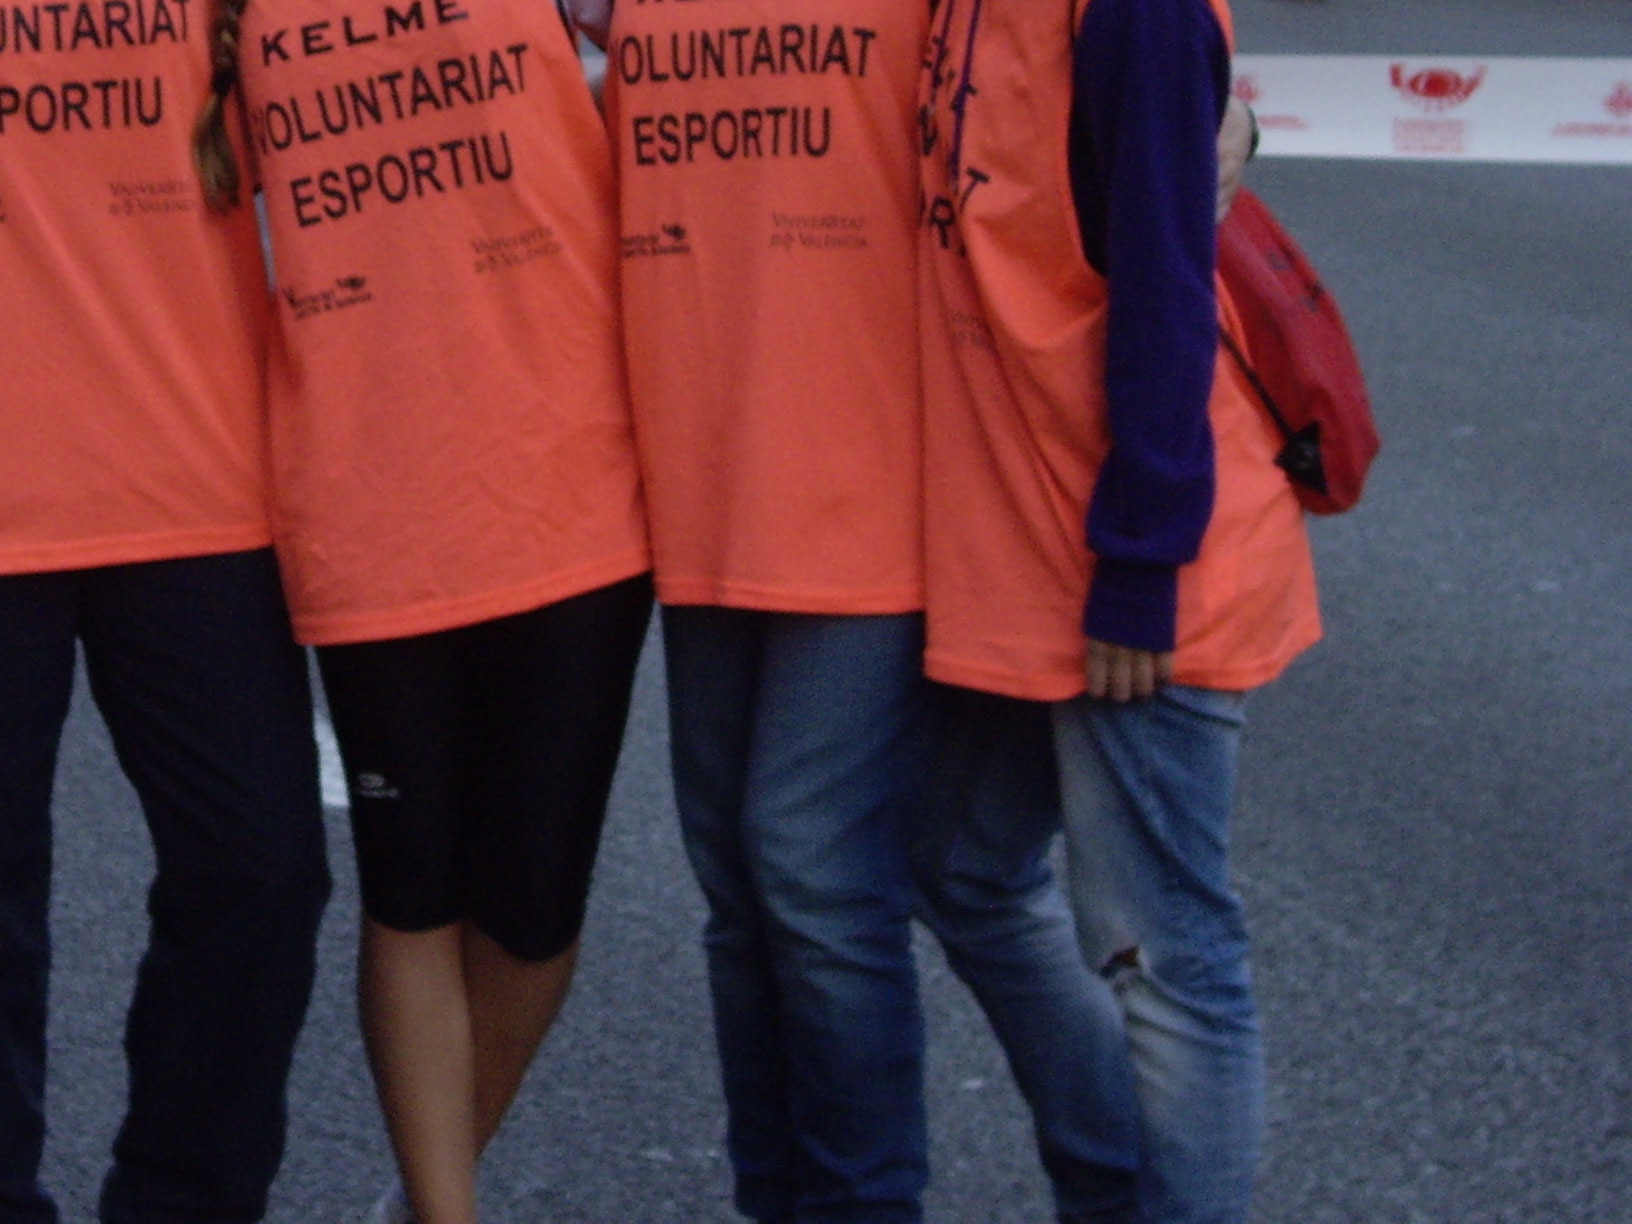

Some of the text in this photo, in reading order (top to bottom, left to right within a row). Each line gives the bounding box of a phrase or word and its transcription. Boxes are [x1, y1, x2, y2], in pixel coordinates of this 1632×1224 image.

[618, 23, 877, 85] OLUNTARIAT
[633, 106, 831, 166] ESPORTIU
[290, 131, 513, 227] ESPORTIU
